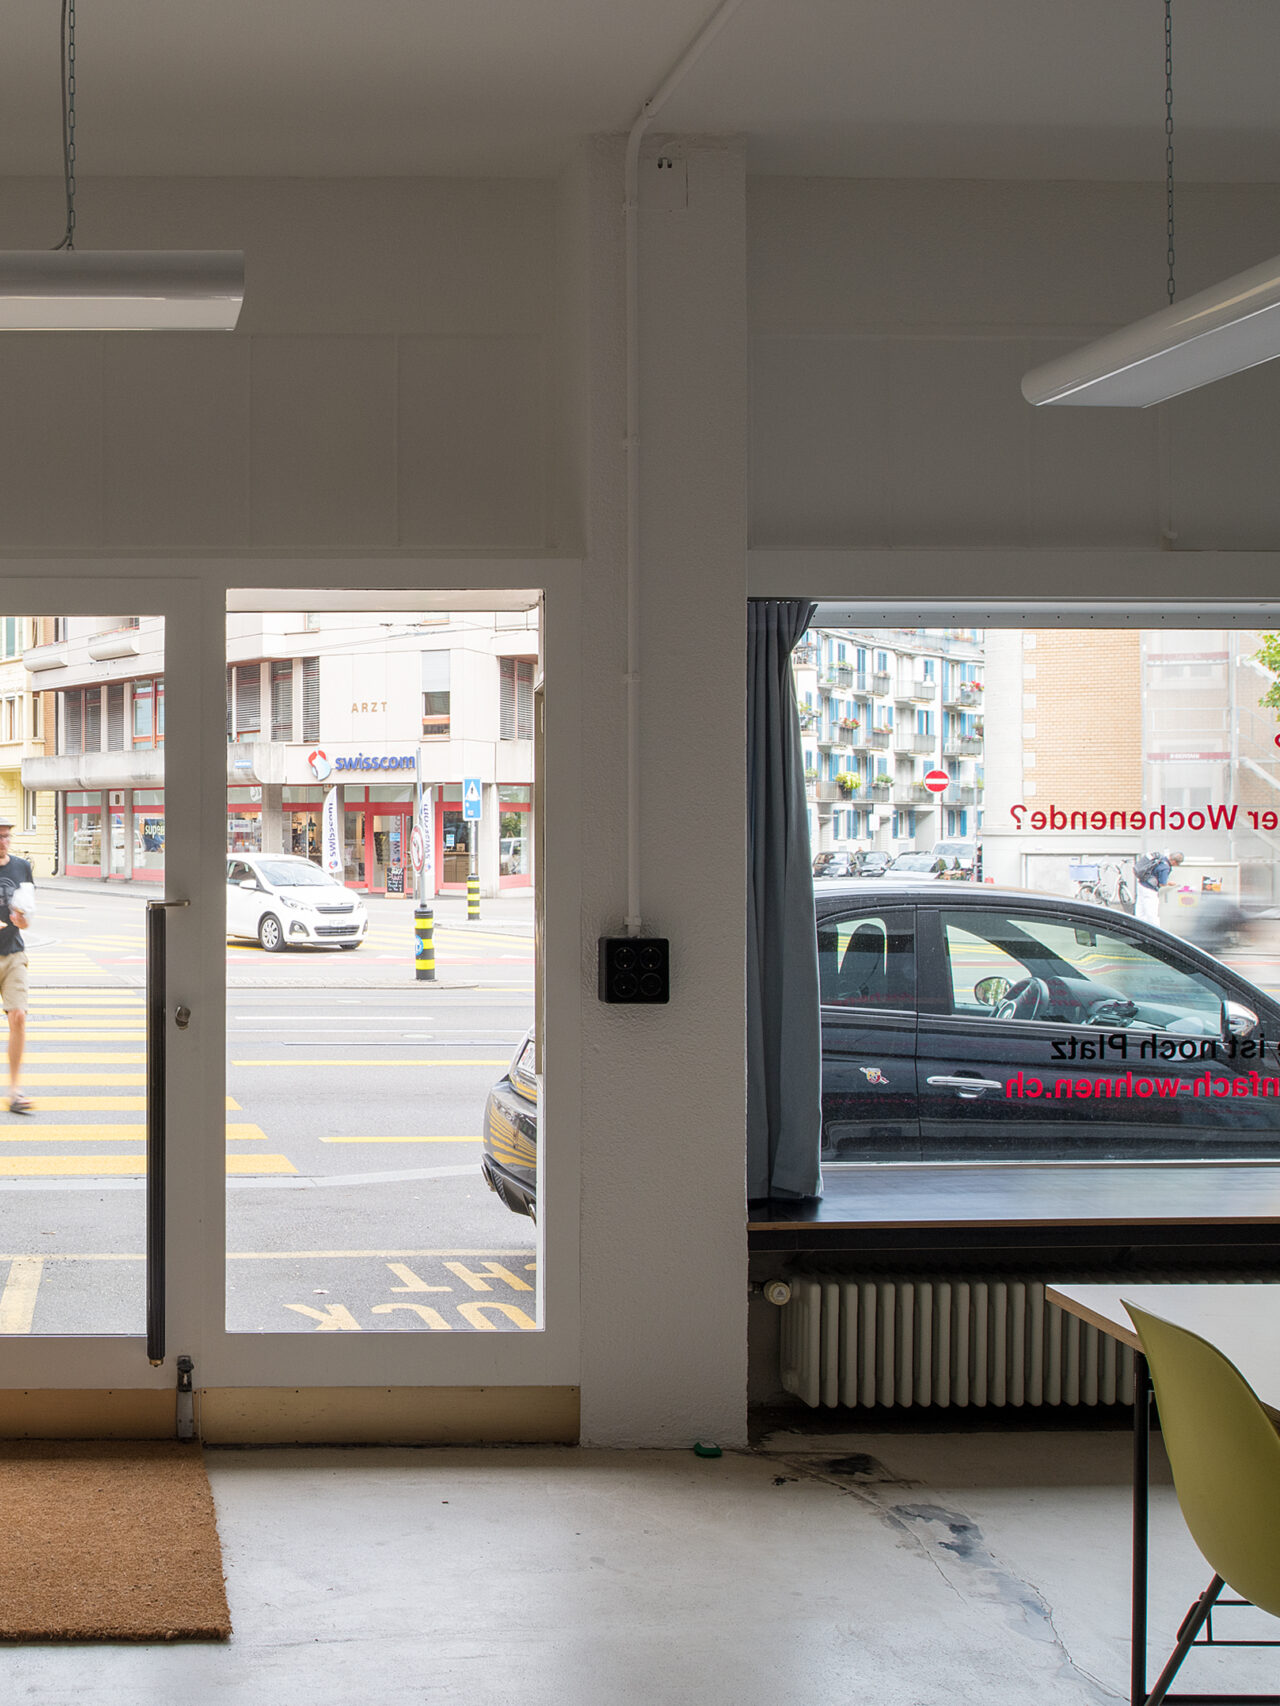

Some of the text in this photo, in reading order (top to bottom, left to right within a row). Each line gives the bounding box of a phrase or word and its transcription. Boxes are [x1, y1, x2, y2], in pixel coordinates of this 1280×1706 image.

[351, 701, 387, 712] ARZT
[335, 752, 415, 771] swisscom
[327, 802, 337, 858] swisscom
[386, 1262, 536, 1293] HT
